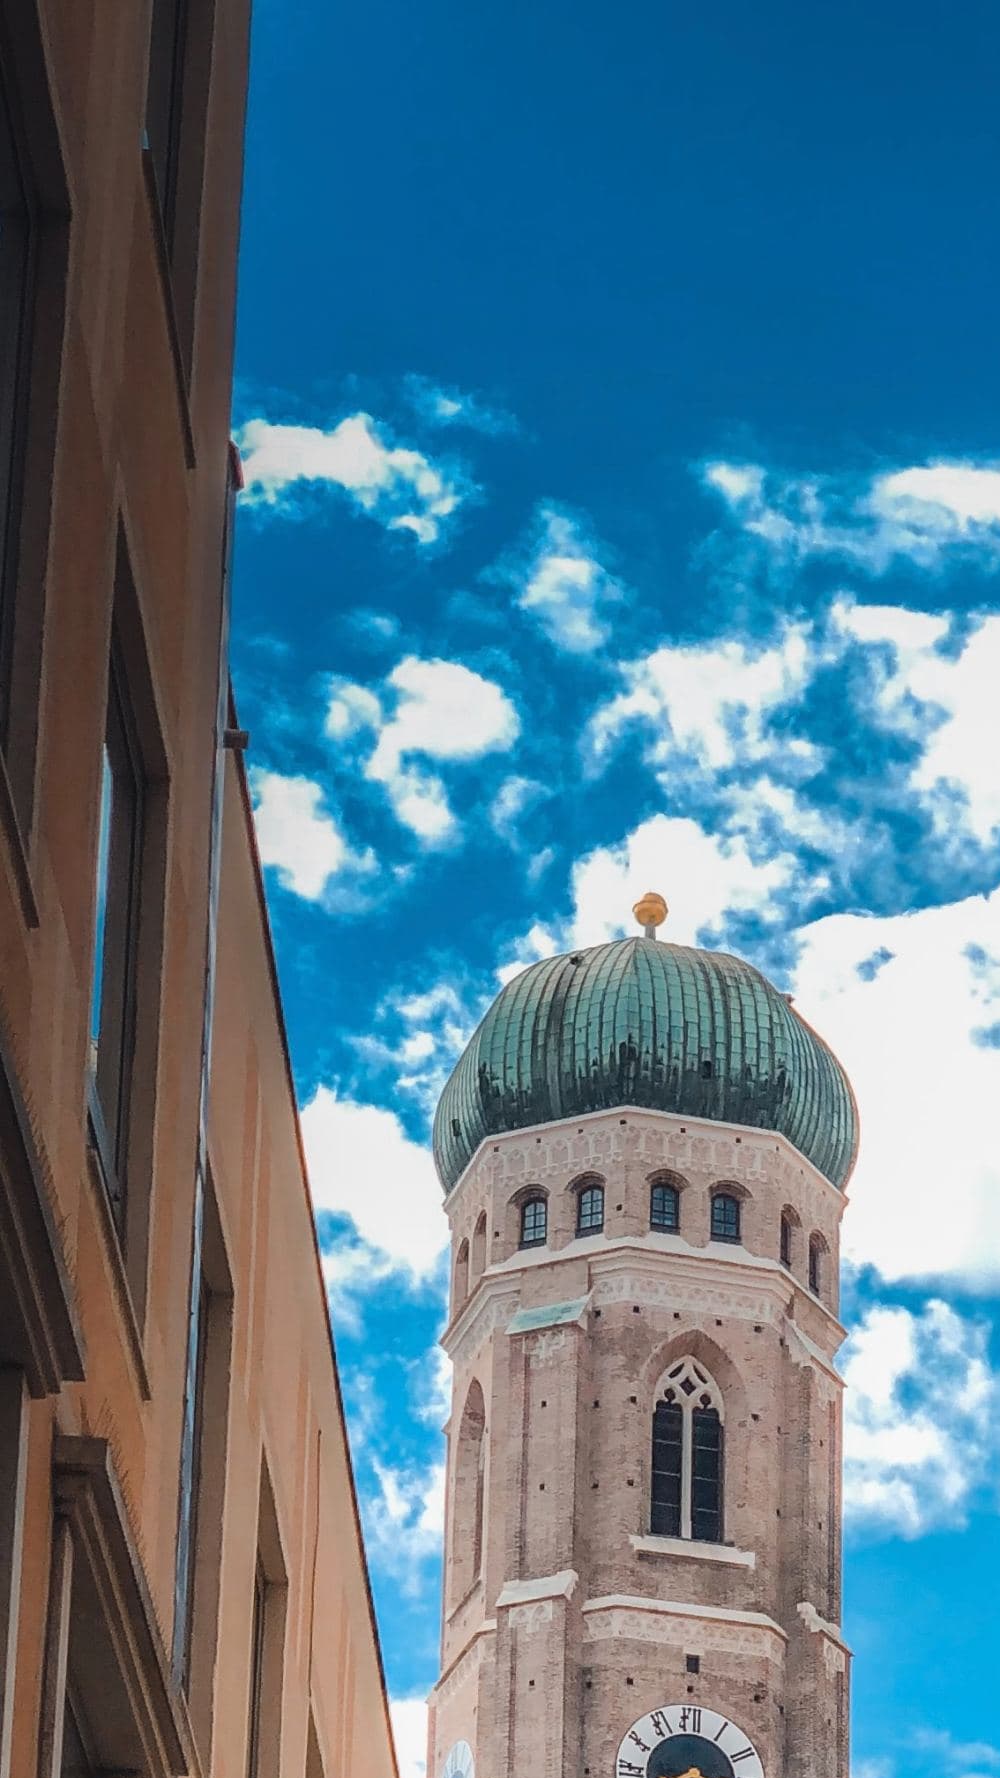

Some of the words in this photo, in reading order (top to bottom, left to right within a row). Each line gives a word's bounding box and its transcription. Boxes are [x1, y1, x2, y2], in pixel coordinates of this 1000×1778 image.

[650, 1711, 673, 1737] XI
[679, 1707, 702, 1733] XII
[629, 1731, 651, 1752] X
[714, 1722, 728, 1741] I
[730, 1747, 755, 1763] II
[619, 1759, 644, 1778] IX
